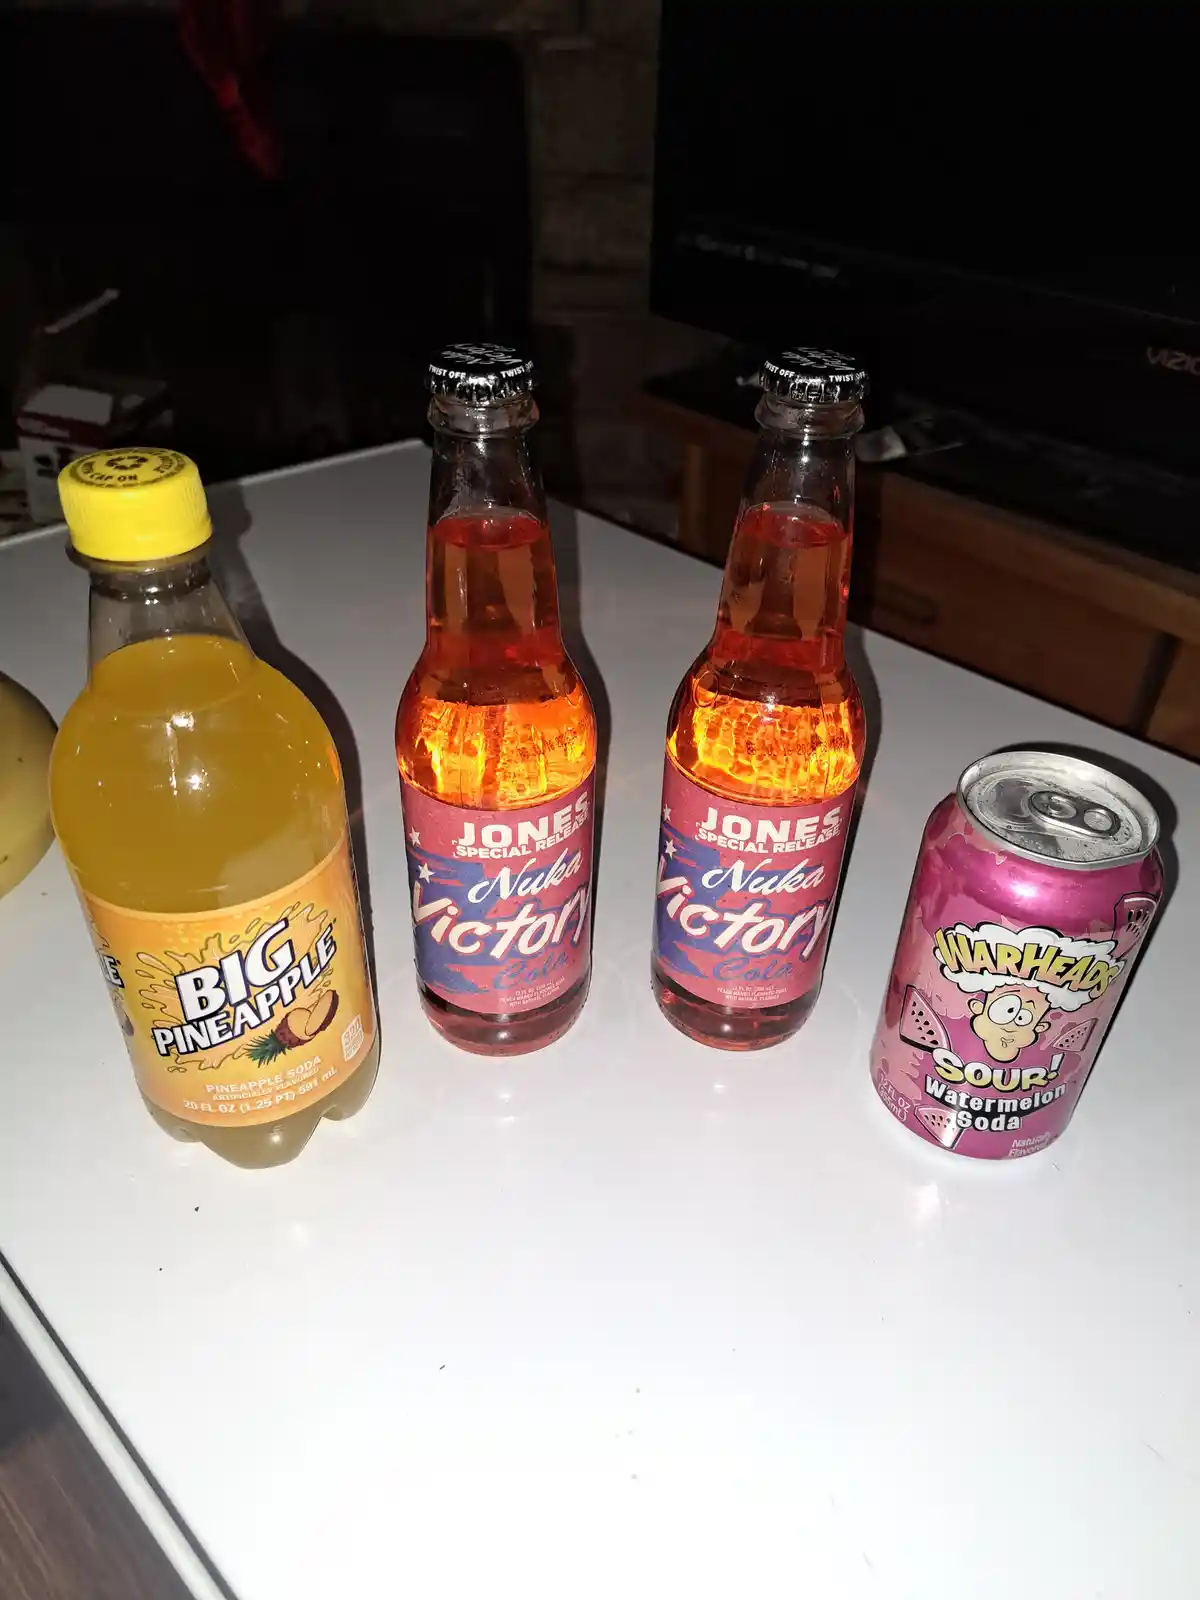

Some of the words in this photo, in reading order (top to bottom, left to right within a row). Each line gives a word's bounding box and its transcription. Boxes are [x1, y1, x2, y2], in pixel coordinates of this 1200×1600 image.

[428, 363, 447, 377] TWIST
[448, 370, 467, 380] OFF
[500, 364, 525, 379] TWIST
[779, 368, 796, 379] OFF
[828, 373, 854, 383] TWIST
[117, 473, 138, 482] ON
[457, 791, 590, 850] JONES
[698, 828, 769, 853] SPECIAL
[772, 824, 842, 853] RELEASE
[701, 806, 842, 843] JONES
[456, 844, 532, 859] SPECIAL
[467, 848, 583, 904] Nuka
[702, 858, 826, 894] Nuka
[412, 881, 589, 958] Victory
[656, 855, 830, 958] Victory
[175, 918, 296, 1022] BIG
[493, 952, 569, 990] Cola
[713, 956, 794, 981] Cola
[935, 927, 1119, 999] WARHEADS
[152, 922, 338, 1057] PINEAPPLE
[205, 1073, 283, 1093] PINEAPPLE
[287, 1055, 322, 1077] SODA
[932, 1047, 1065, 1092] SOUR!
[183, 1100, 199, 1110] 20
[201, 1103, 214, 1112] FL
[218, 1103, 236, 1113] OZ
[239, 1099, 272, 1114] (1.25
[275, 1090, 296, 1105] PT)
[298, 1080, 318, 1095] 591
[887, 1084, 897, 1101] FL
[898, 1097, 911, 1113] OZ
[925, 1075, 1067, 1114] Watermelon
[955, 1109, 1021, 1131] Soda
